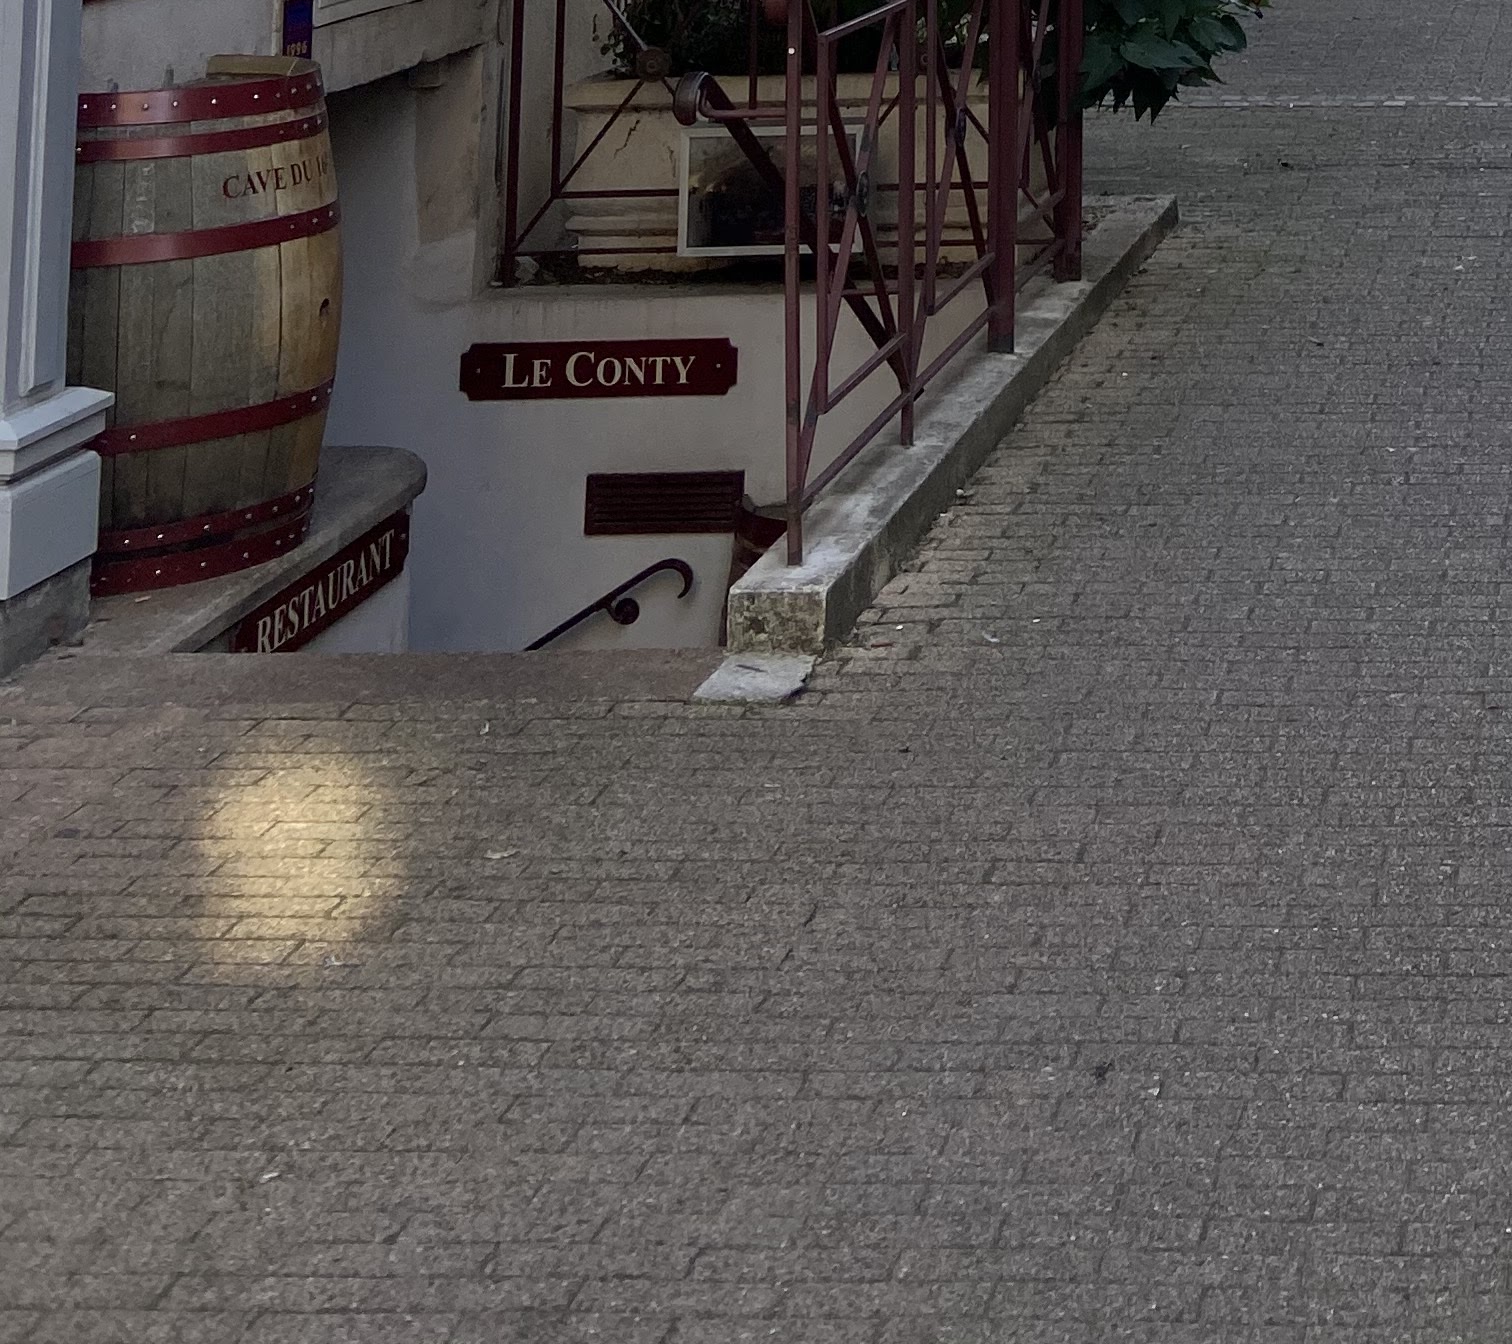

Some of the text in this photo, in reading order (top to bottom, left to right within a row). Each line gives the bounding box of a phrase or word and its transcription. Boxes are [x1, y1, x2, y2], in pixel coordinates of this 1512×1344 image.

[222, 167, 287, 199] CAVE
[290, 159, 313, 187] DU
[502, 349, 696, 389] LE CONTY
[256, 529, 395, 654] RESTAURANT
